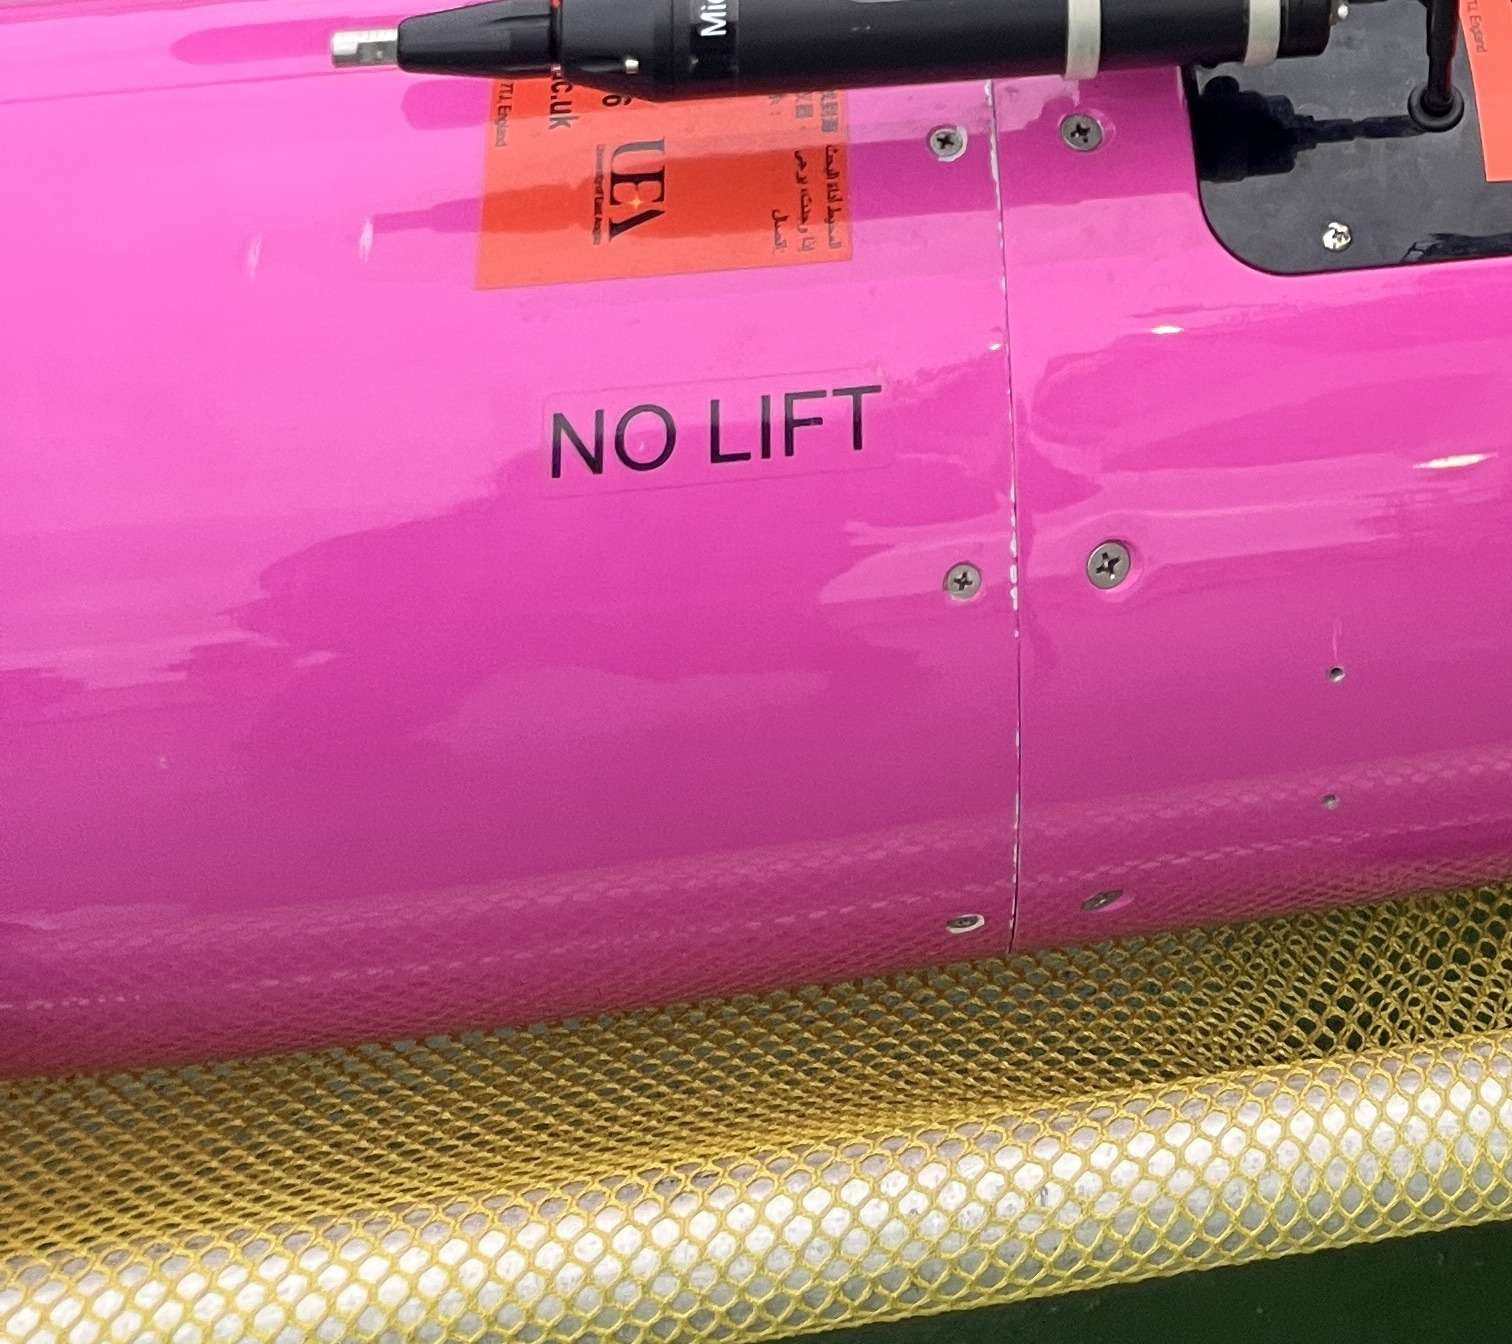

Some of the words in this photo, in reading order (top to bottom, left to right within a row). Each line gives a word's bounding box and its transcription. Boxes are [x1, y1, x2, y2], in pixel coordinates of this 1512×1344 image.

[608, 137, 666, 242] UEA
[551, 403, 677, 479] NO
[709, 384, 882, 464] LIFT
